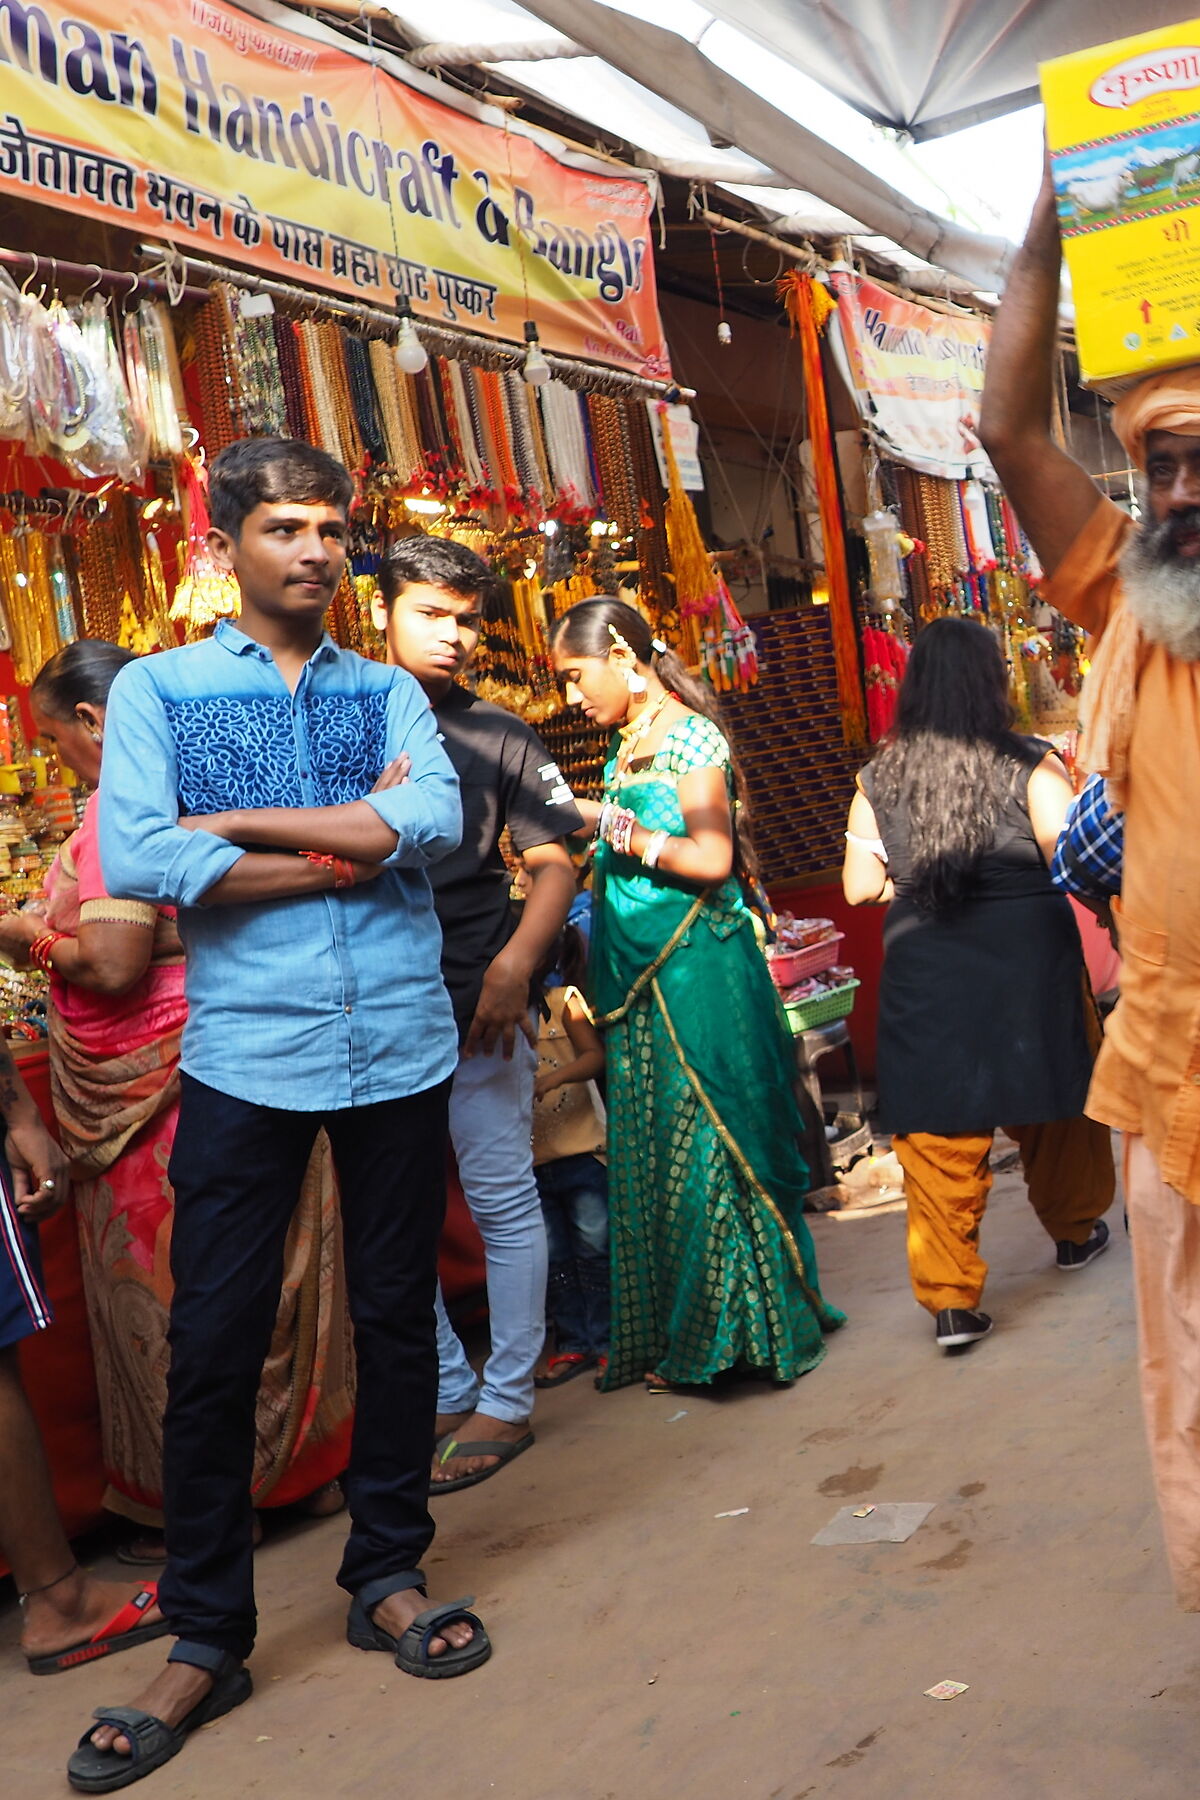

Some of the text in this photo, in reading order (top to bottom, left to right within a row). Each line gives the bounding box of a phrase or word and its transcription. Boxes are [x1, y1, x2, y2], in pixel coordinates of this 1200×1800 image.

[171, 37, 461, 228] Handicraft
[147, 171, 222, 236] भवन
[228, 194, 260, 245] के
[265, 214, 324, 268] पास
[329, 233, 380, 287] ब्रह्म
[383, 252, 428, 301] घाट
[432, 268, 498, 322] पुष्कर
